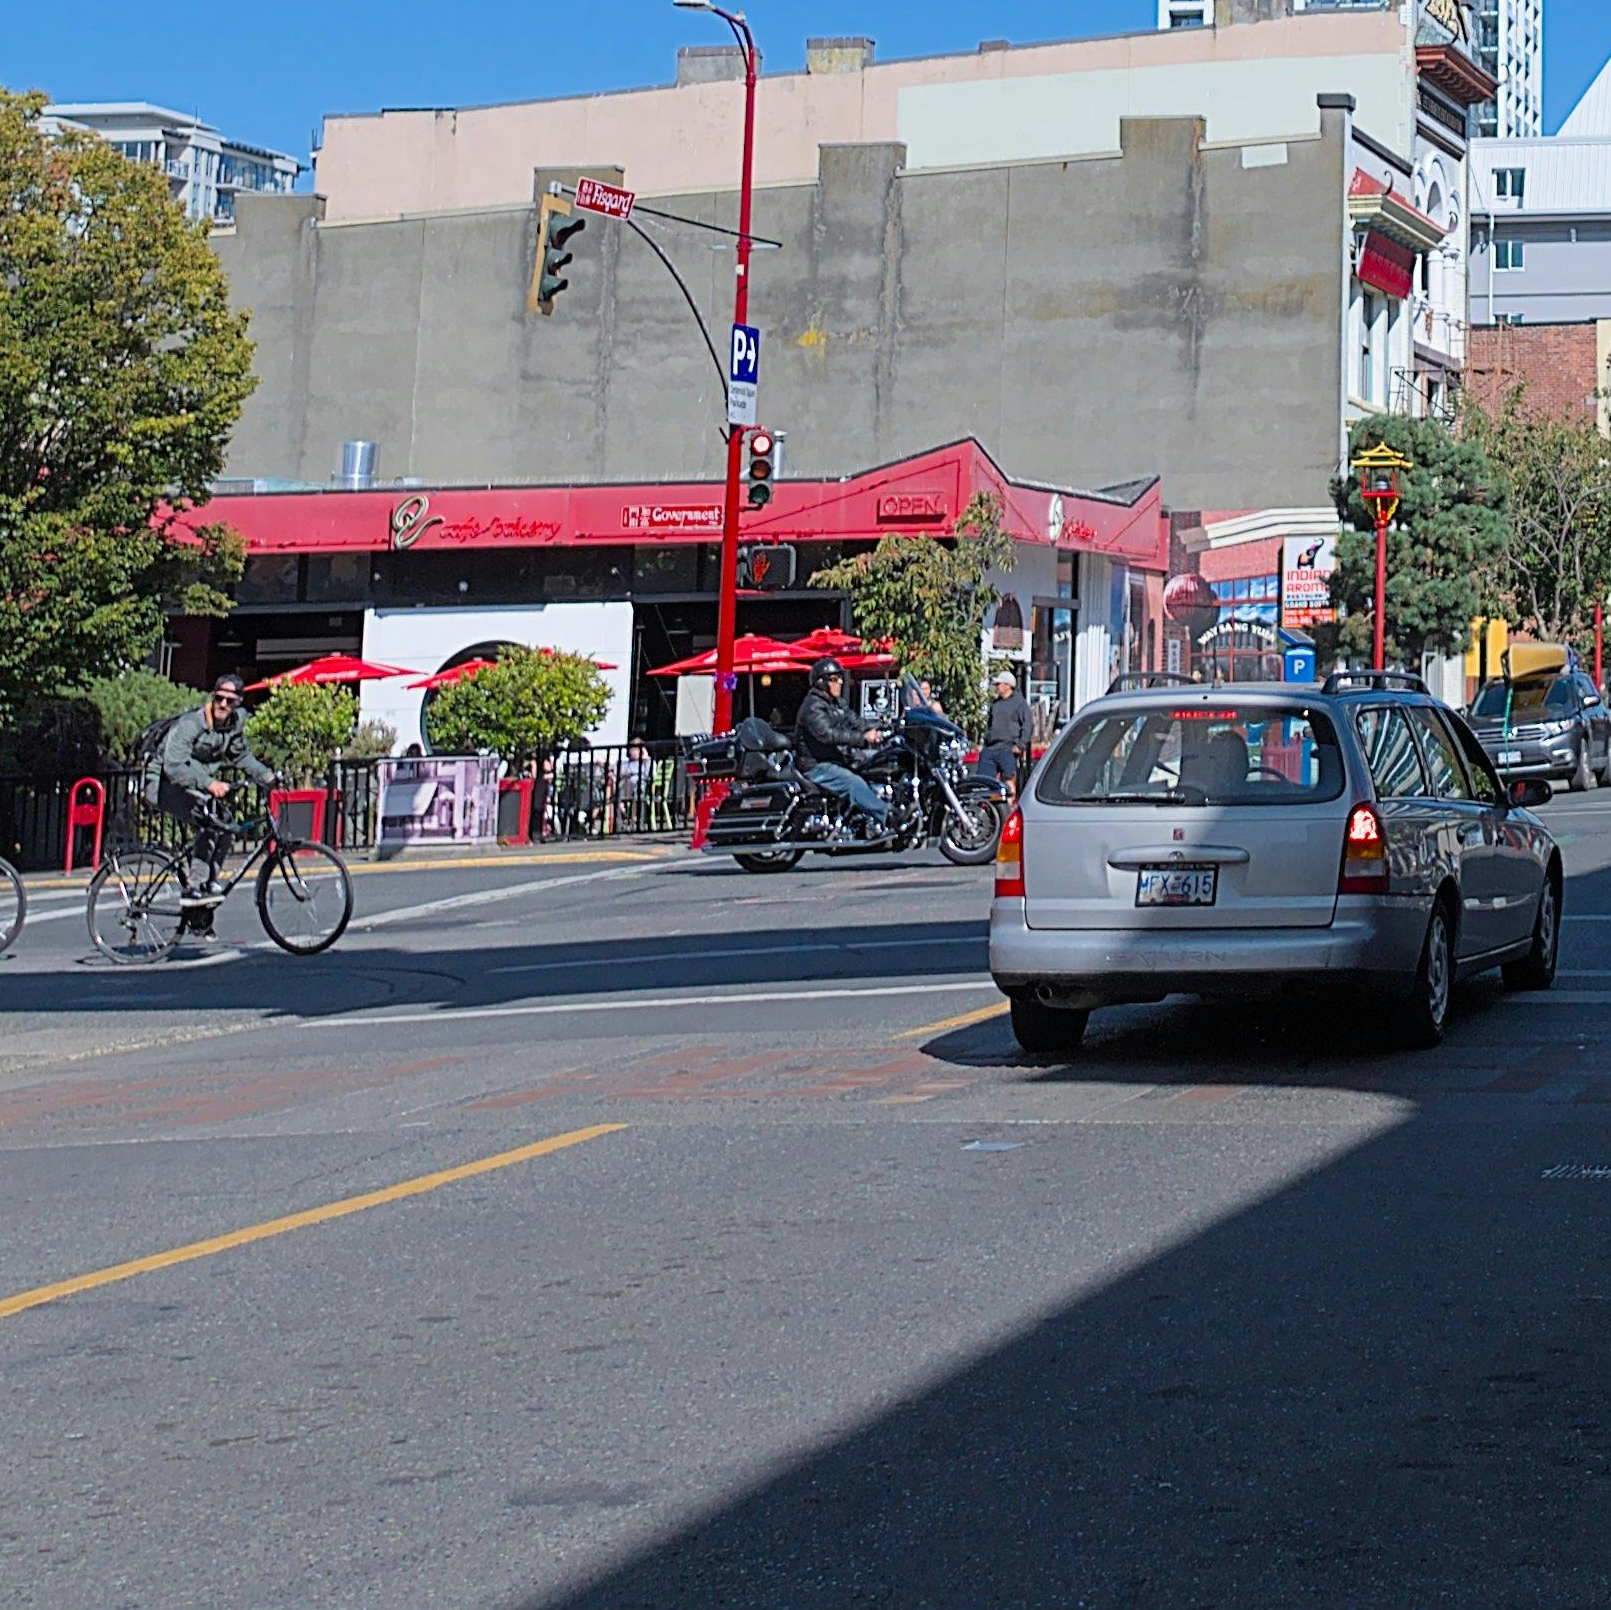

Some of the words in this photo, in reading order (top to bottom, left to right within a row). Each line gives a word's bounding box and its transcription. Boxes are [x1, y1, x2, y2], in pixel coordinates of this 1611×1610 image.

[592, 184, 632, 212] Fisgard
[733, 329, 747, 376] P
[883, 495, 939, 515] OPEN
[652, 506, 720, 527] Government
[1294, 659, 1305, 674] P
[1181, 875, 1212, 895] 615
